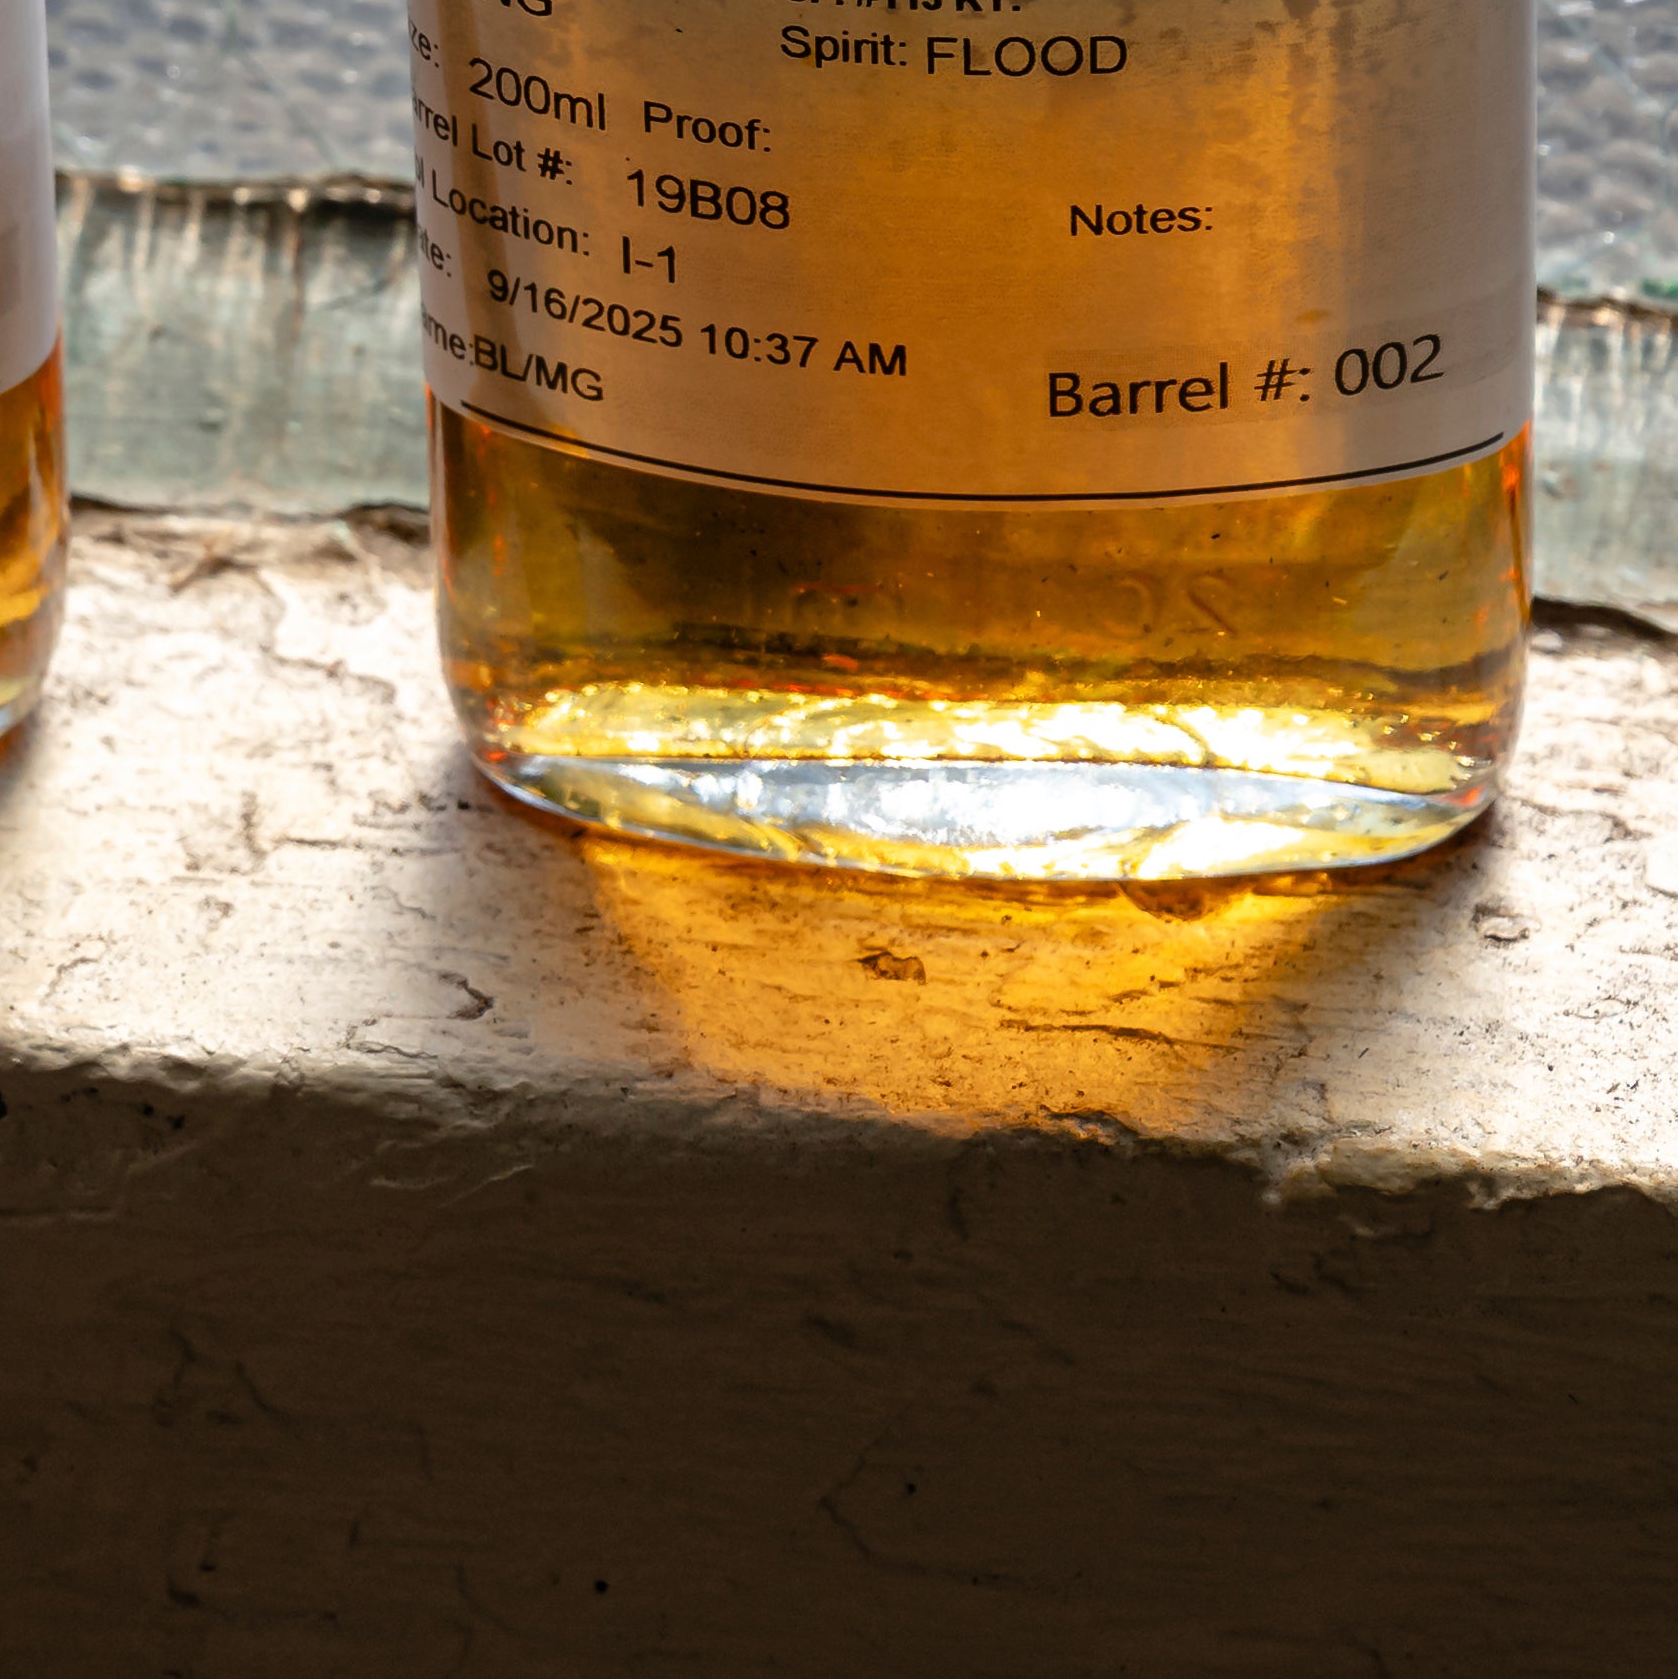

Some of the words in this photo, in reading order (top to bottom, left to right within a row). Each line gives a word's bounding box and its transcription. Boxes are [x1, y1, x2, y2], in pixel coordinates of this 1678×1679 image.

[781, 25, 907, 69] Spirit:
[926, 35, 1128, 77] FLOOD
[469, 57, 607, 131] 200ml
[643, 100, 772, 153] Proof:
[431, 168, 591, 257] Location:
[471, 122, 527, 172] Lot
[537, 147, 573, 186] #:
[626, 168, 791, 230] 19B08
[1069, 203, 1214, 237] Notes:
[487, 268, 683, 349] 9/16/2025
[699, 323, 820, 370] 10:37
[832, 340, 908, 377] AM
[1048, 361, 1229, 419] Barrel
[1254, 357, 1312, 403] #:
[1334, 333, 1445, 397] 002
